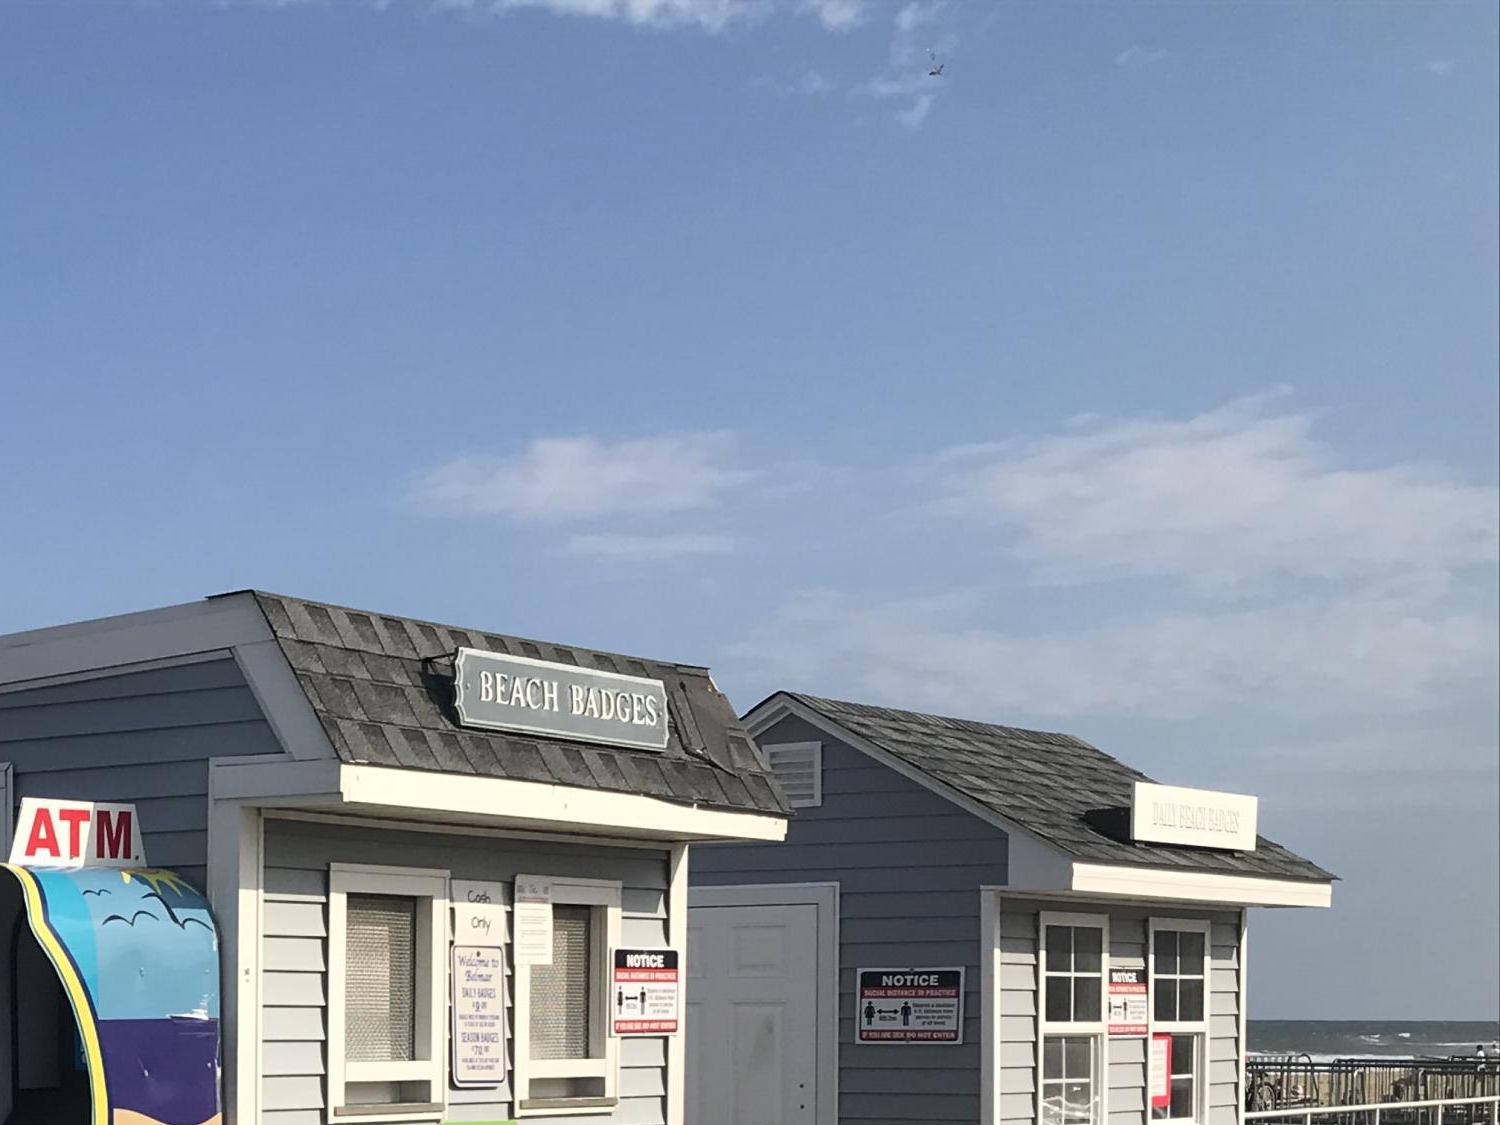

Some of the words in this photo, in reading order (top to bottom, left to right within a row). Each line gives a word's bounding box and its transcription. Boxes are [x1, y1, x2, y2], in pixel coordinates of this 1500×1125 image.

[479, 669, 560, 712] BEACH
[570, 684, 659, 727] BADGES
[24, 807, 132, 860] ATM
[467, 890, 492, 904] Cash
[471, 916, 492, 936] Only
[626, 954, 665, 968] NOTICE
[882, 975, 939, 987] NOTICE
[1112, 972, 1137, 983] NOTICE
